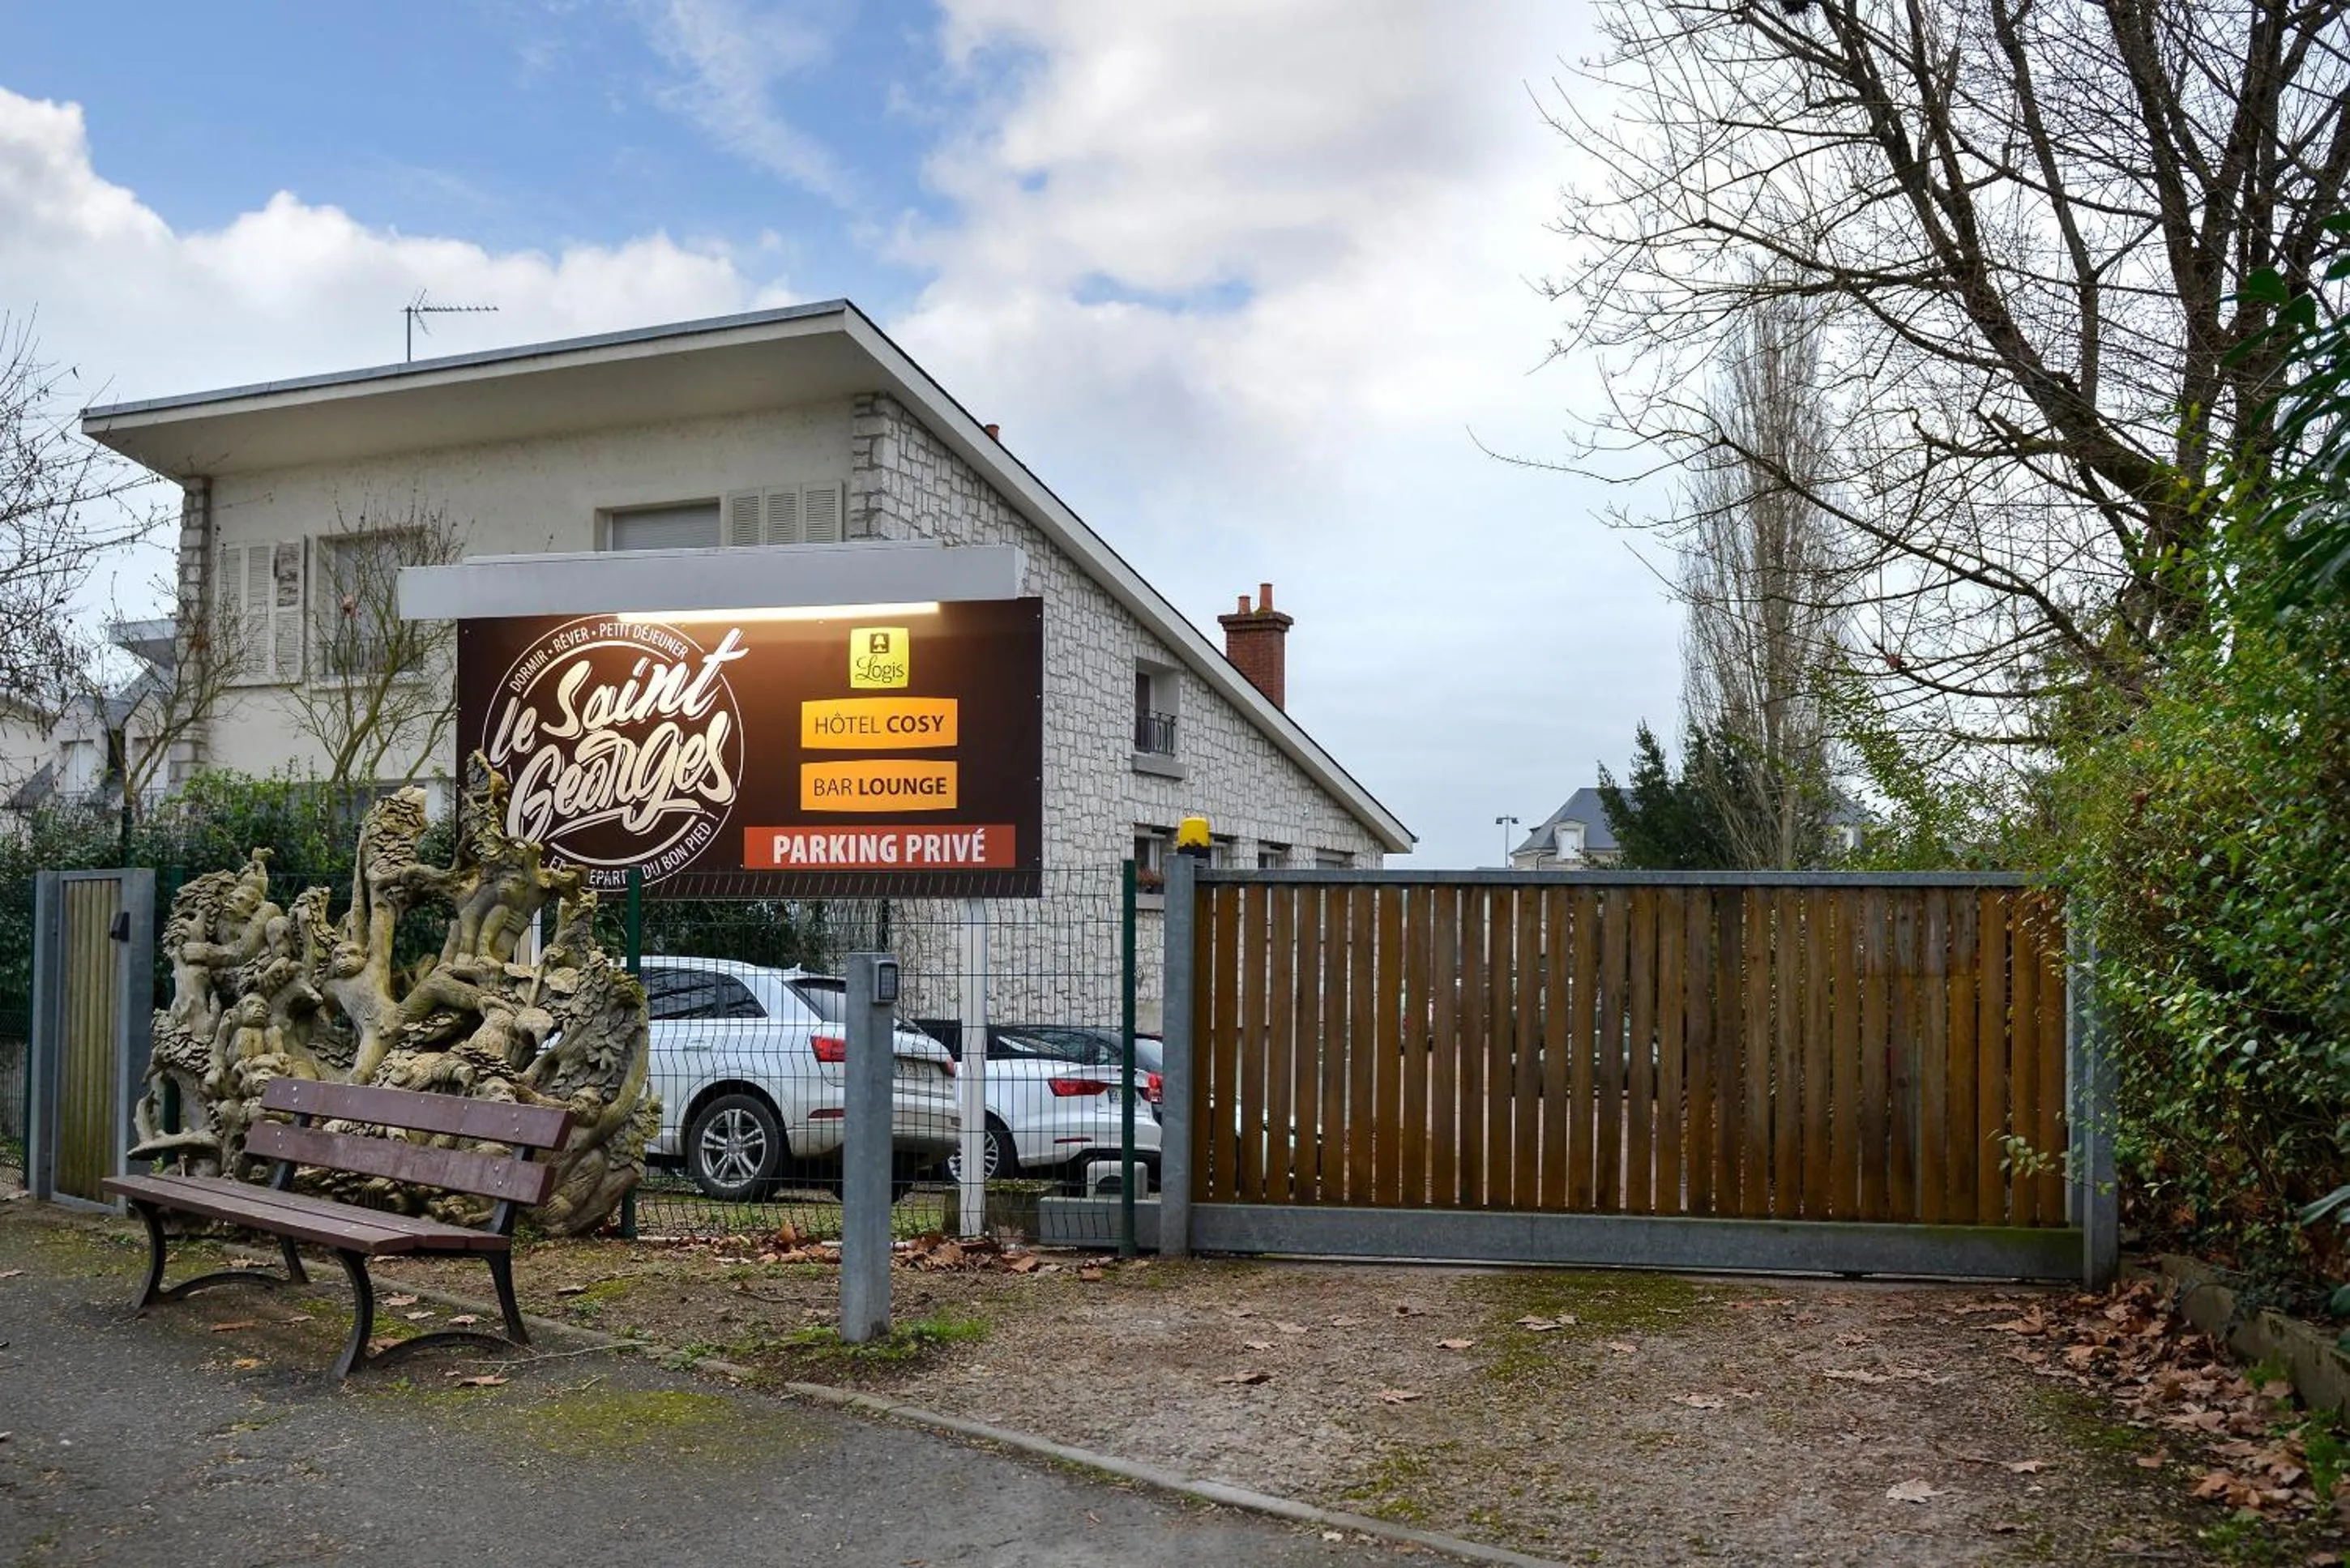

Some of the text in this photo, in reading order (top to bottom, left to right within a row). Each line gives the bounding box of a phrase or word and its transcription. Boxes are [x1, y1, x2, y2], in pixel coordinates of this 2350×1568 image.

[510, 622, 689, 692] DORMIR RÊVER PETIT DÉJEUNER
[855, 655, 904, 683] Logis
[541, 627, 750, 741] Saint
[815, 711, 944, 734] HÔTEL COSY
[506, 711, 736, 844] Georges
[814, 777, 947, 796] BAR LOUNGE
[641, 863, 660, 880] DU
[663, 844, 689, 871] BON
[686, 821, 711, 850] PIED
[773, 828, 985, 864] PARKING PRIVÉ
